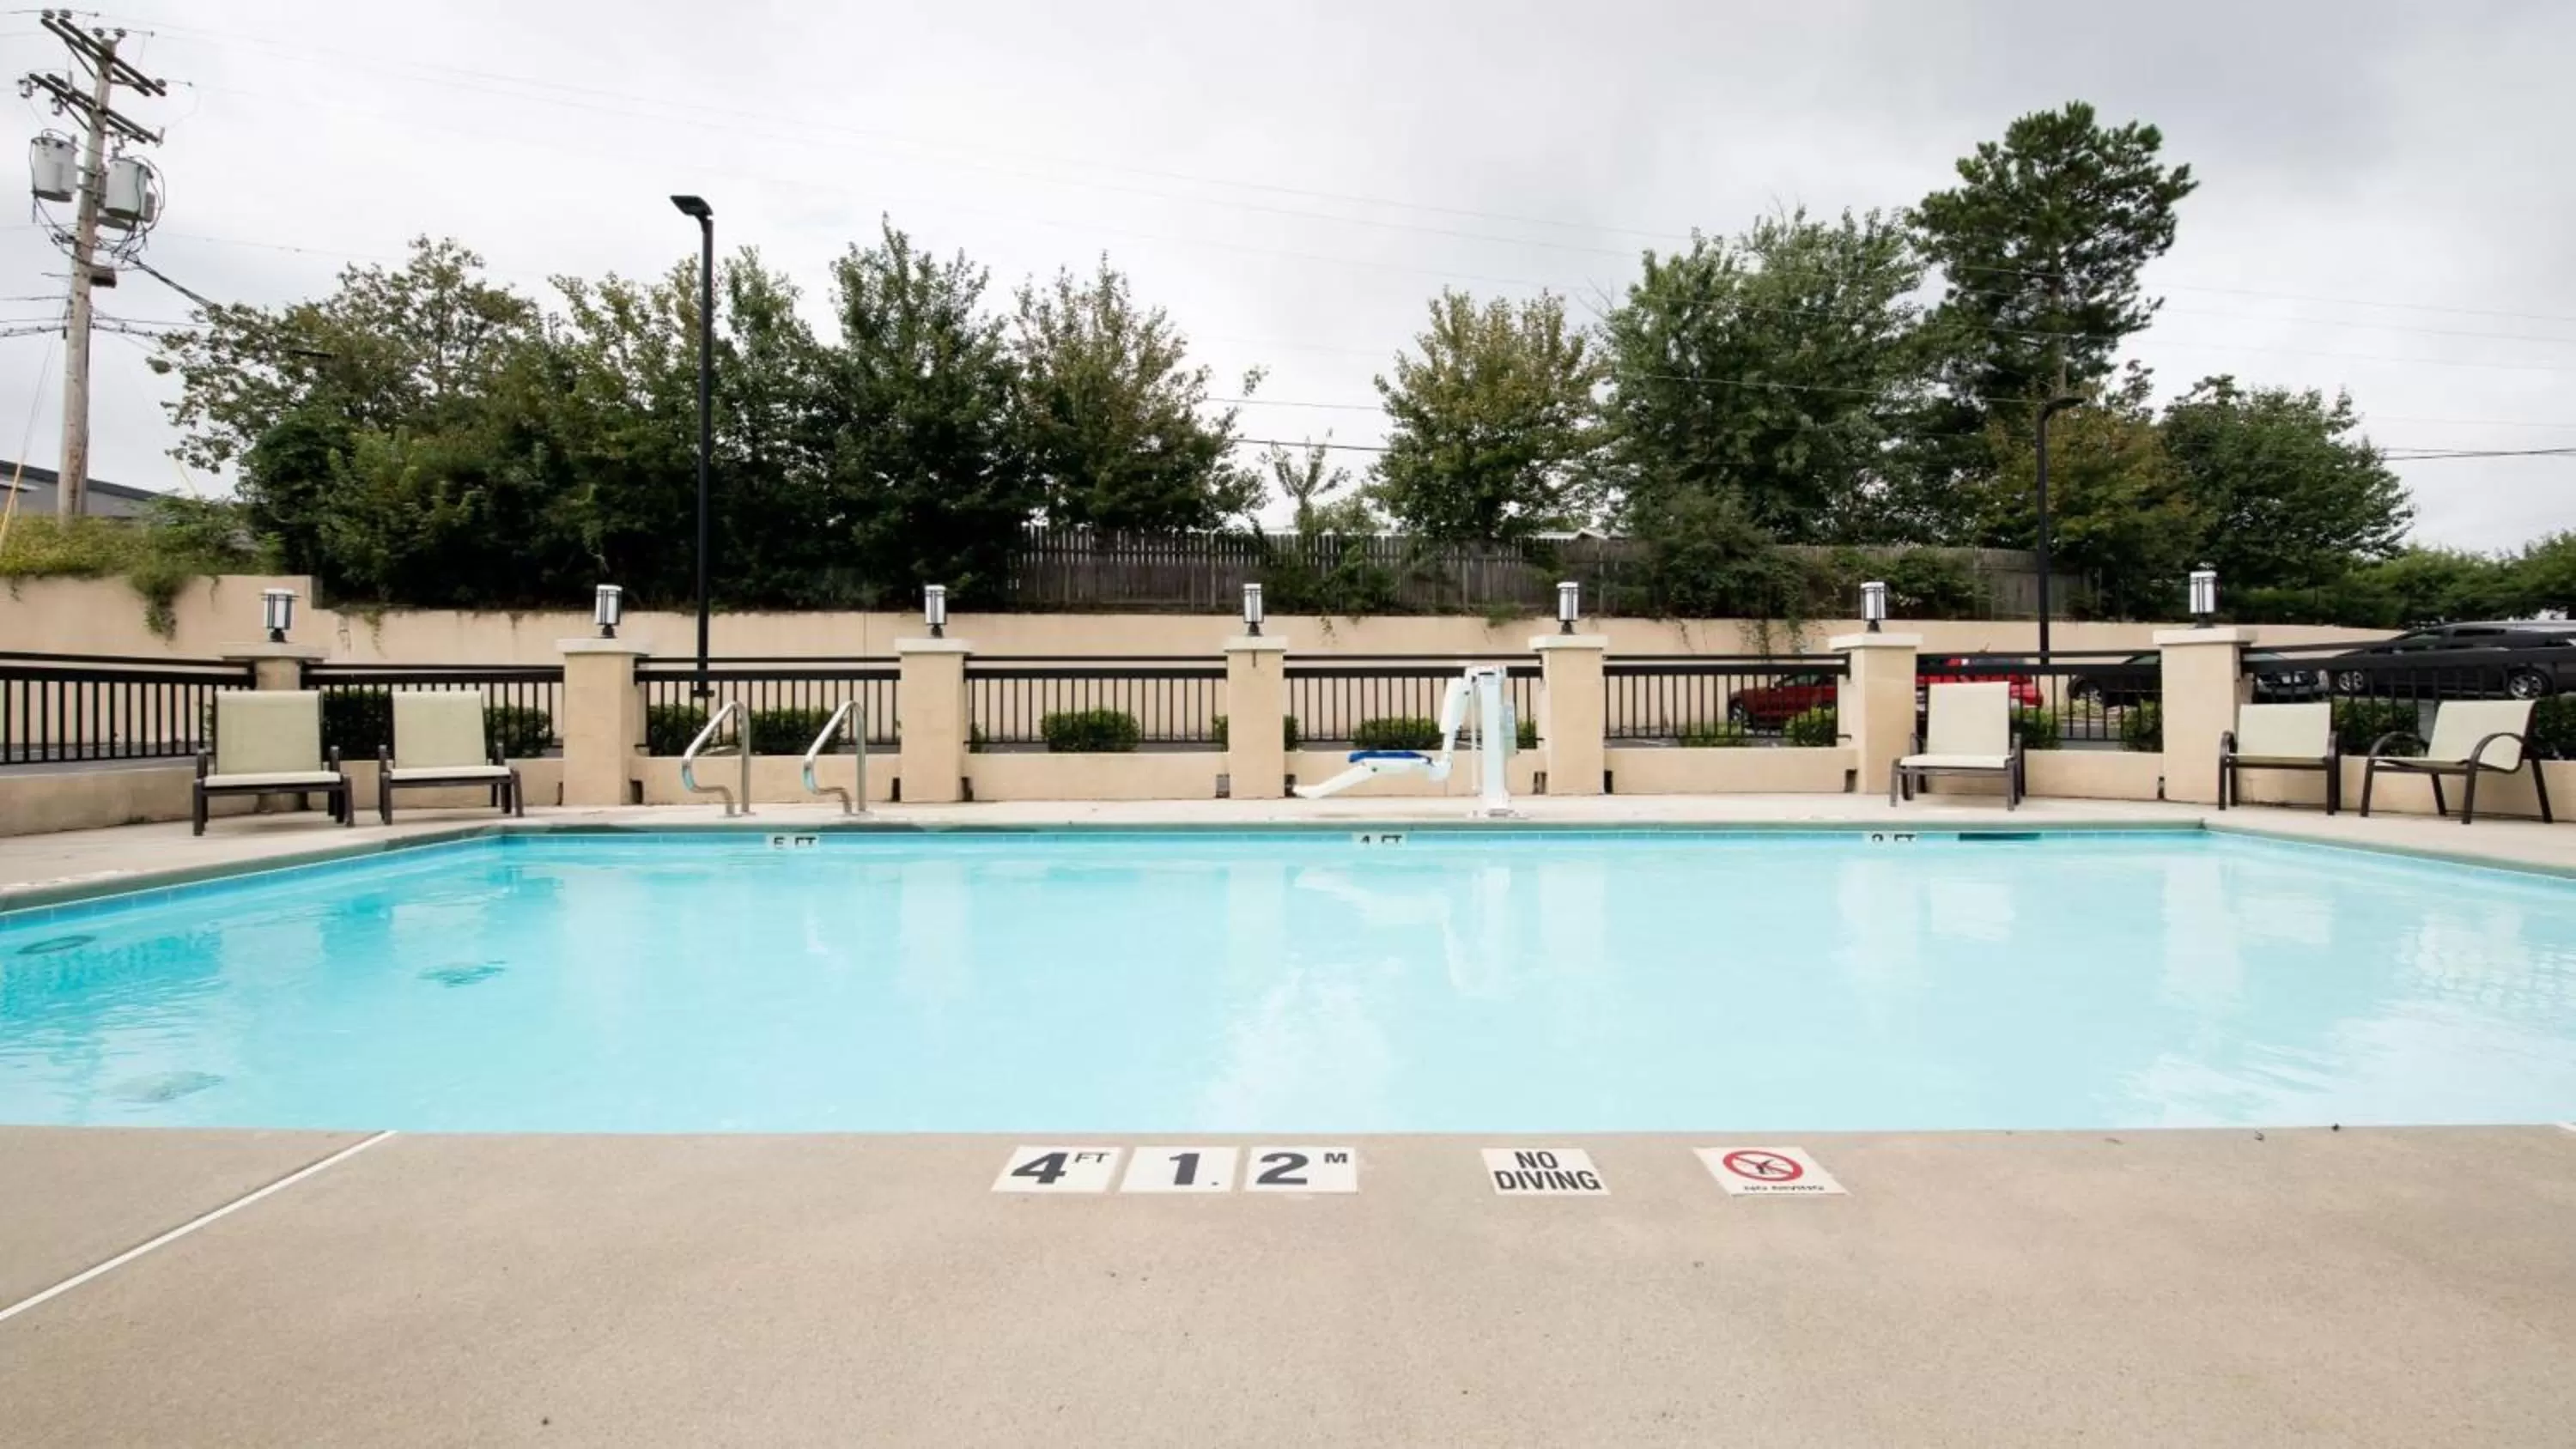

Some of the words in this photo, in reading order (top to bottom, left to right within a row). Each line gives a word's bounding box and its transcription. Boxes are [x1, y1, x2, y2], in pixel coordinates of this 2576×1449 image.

[1324, 1153, 1348, 1164] M
[1514, 1151, 1558, 1169] NO
[1011, 1152, 1068, 1185] 4
[1074, 1152, 1109, 1163] FT
[1494, 1170, 1602, 1191] DIVING
